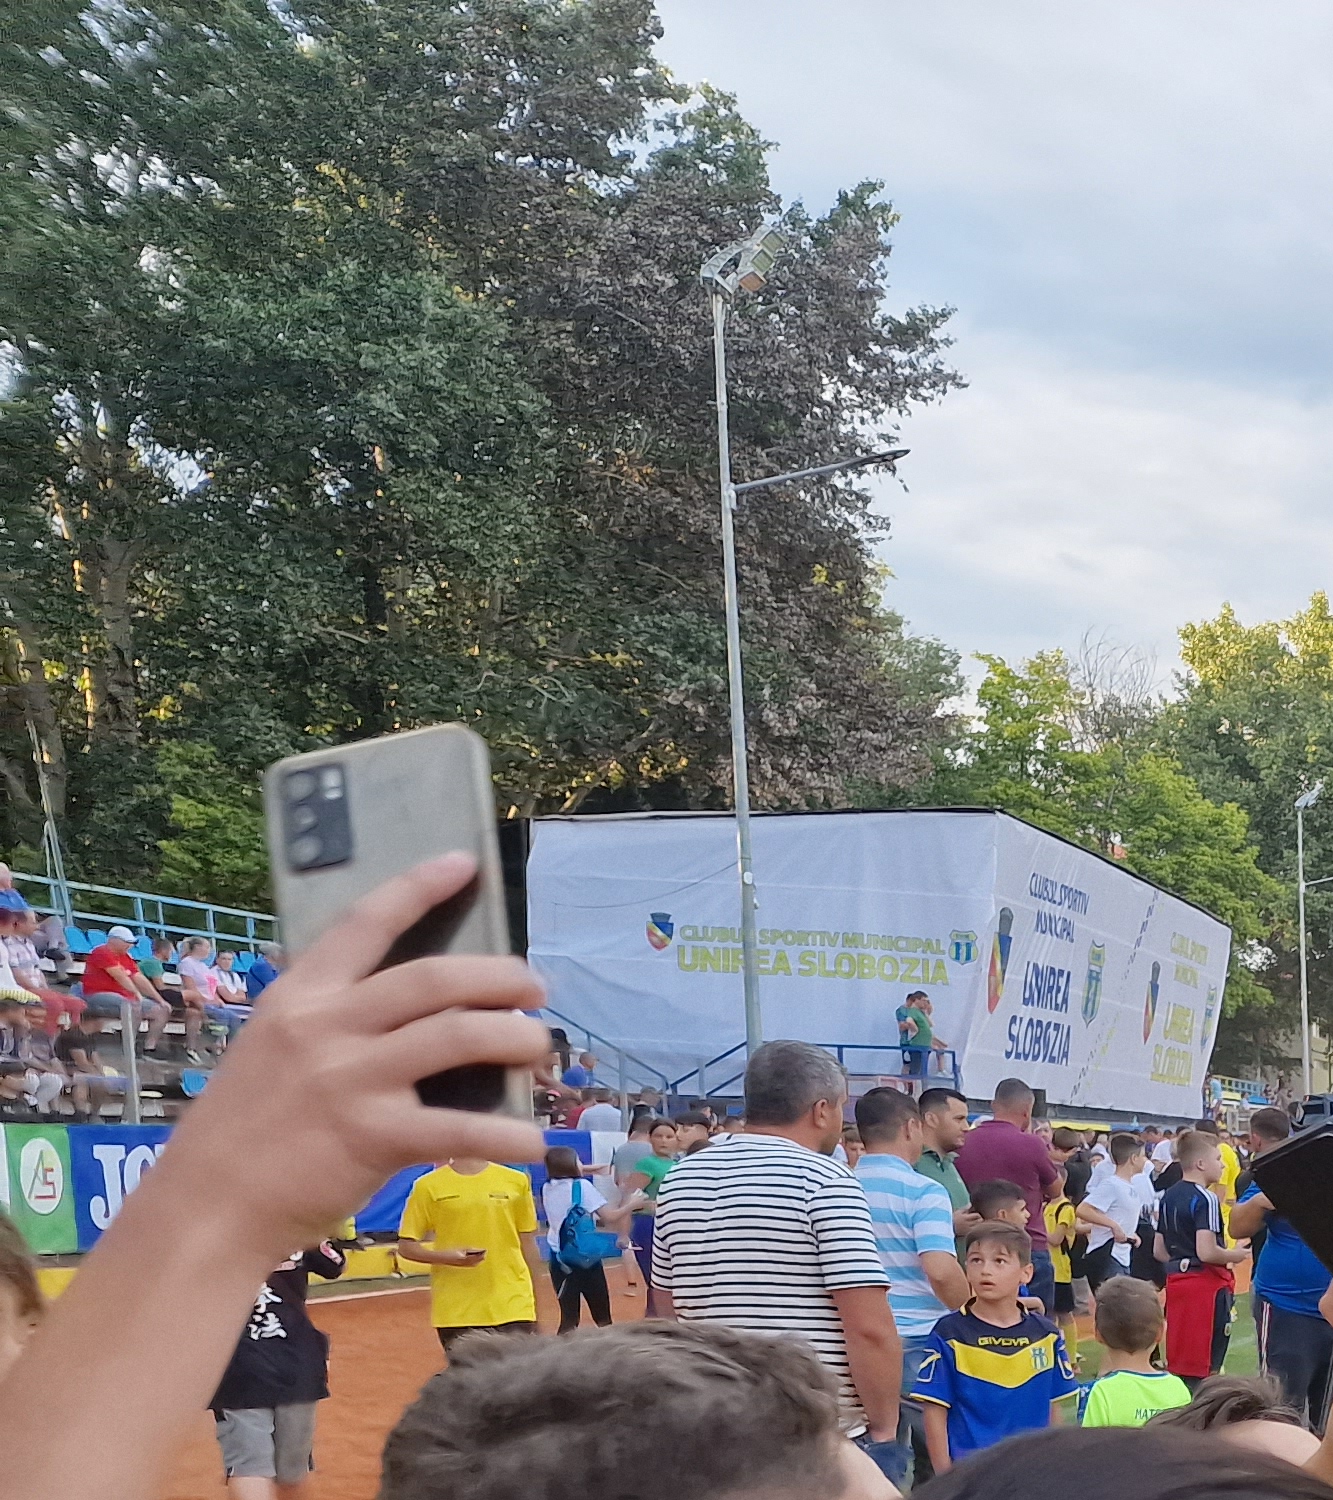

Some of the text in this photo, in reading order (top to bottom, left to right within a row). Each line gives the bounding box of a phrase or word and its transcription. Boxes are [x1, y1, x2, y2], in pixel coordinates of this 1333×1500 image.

[1056, 884, 1090, 916] SPORTIV
[680, 925, 946, 955] CLUBU SPORTIV MUNICIPAL
[798, 951, 949, 986] SLOBOZIA
[1004, 1015, 1072, 1066] SLOBOZIA
[977, 1336, 1030, 1347] GIVOVA
